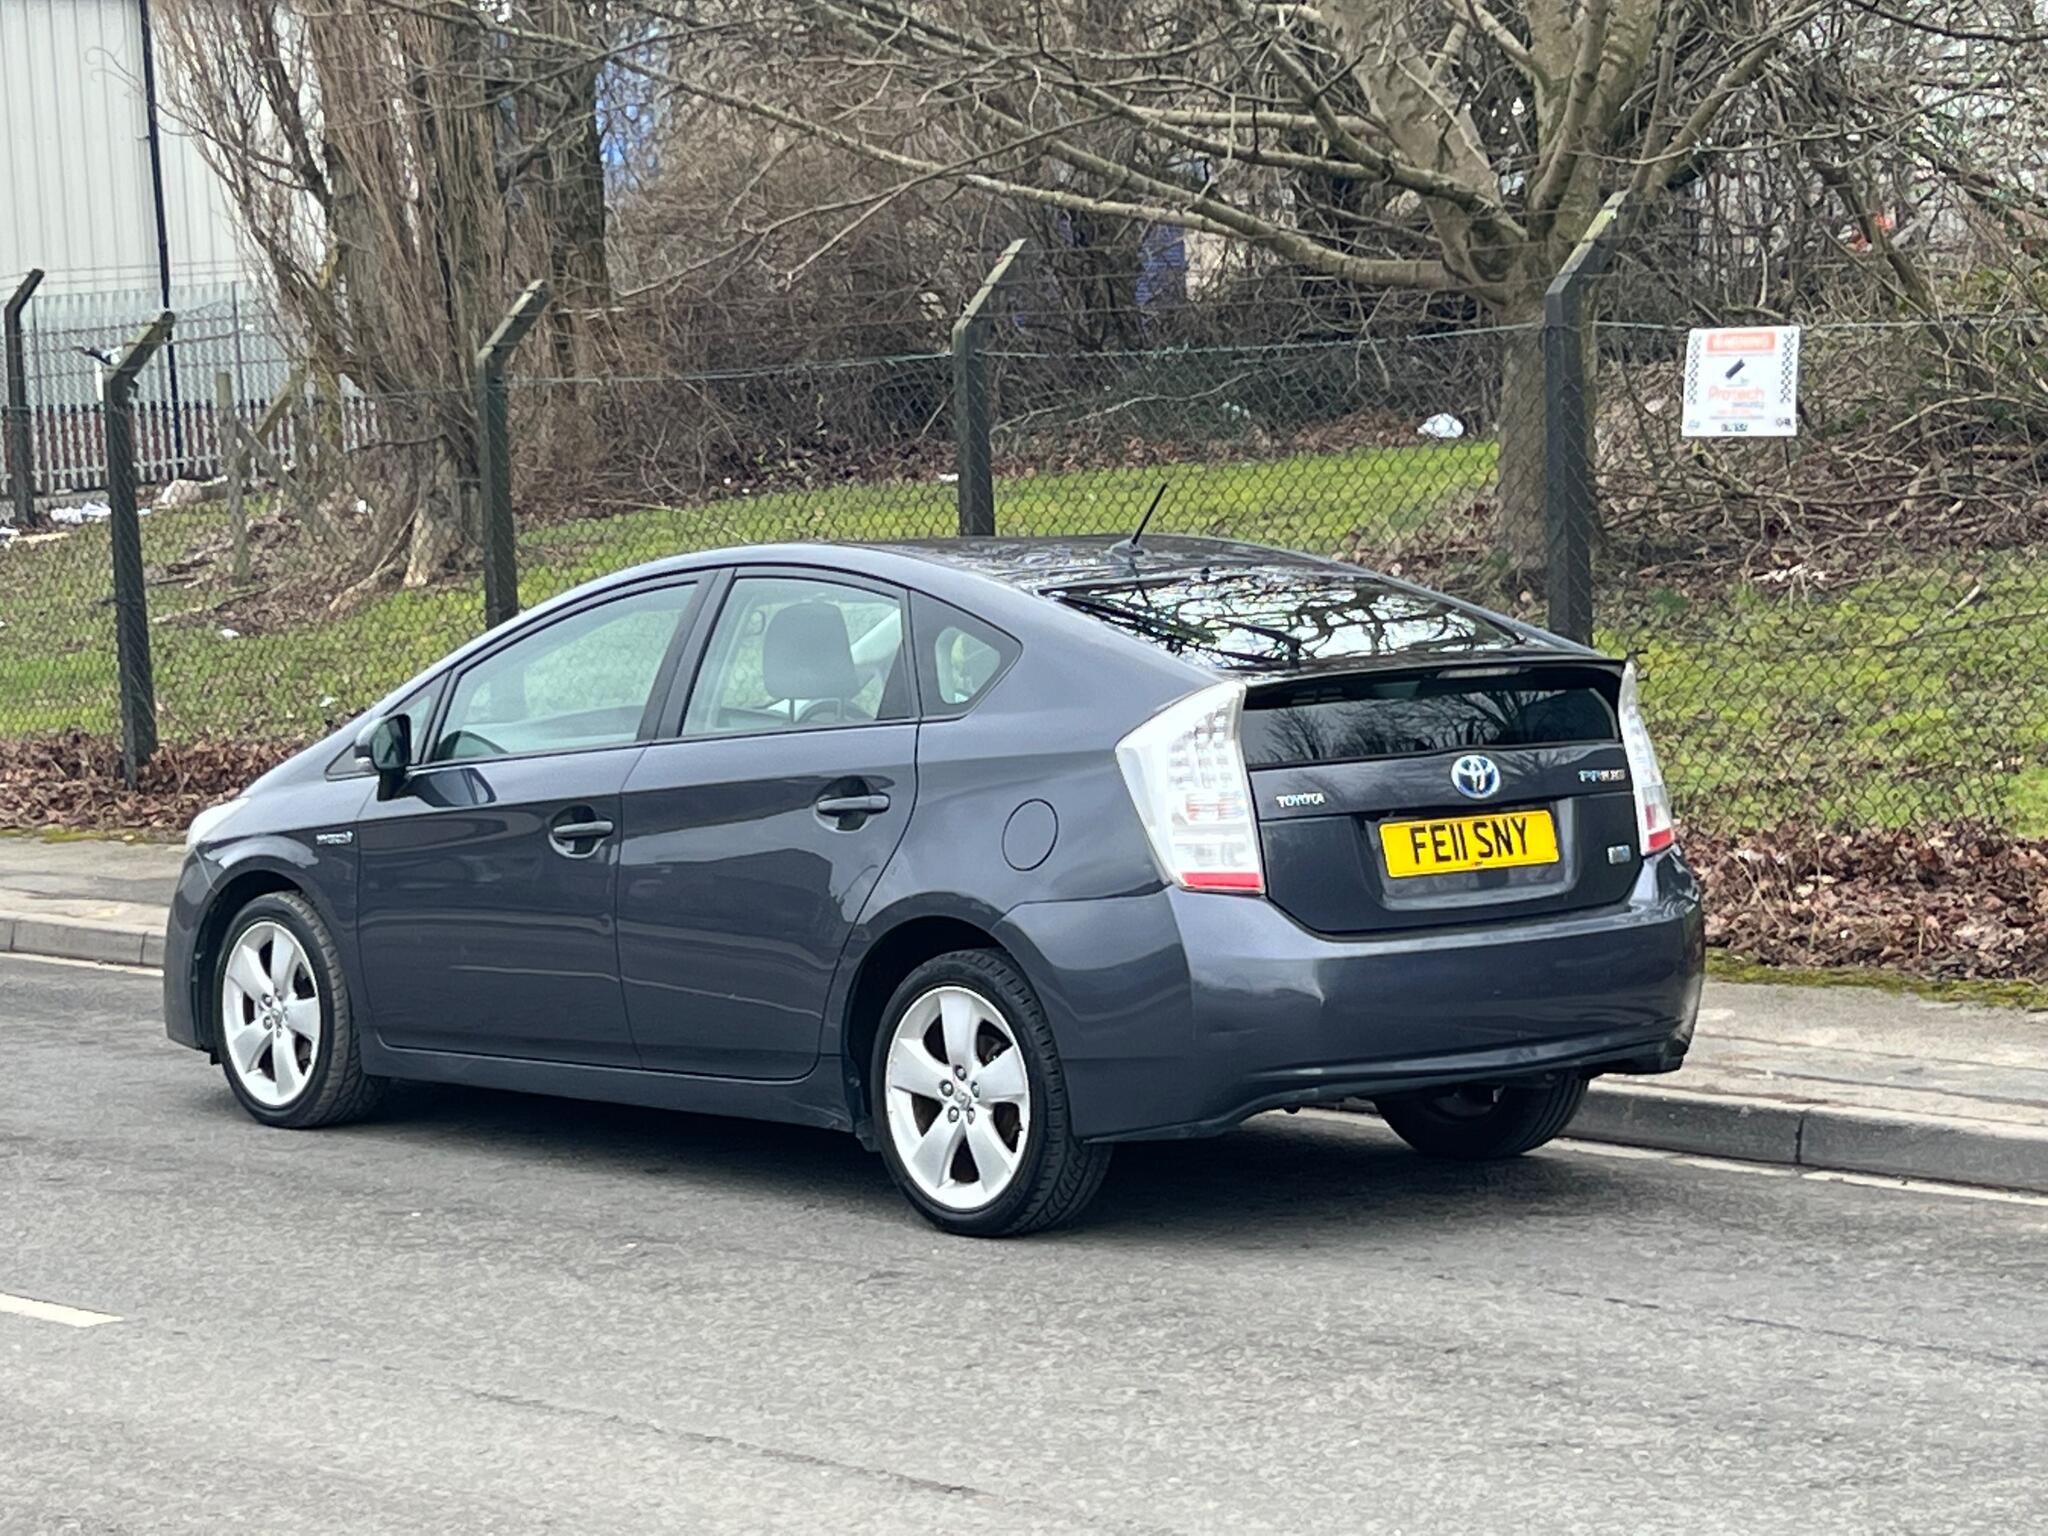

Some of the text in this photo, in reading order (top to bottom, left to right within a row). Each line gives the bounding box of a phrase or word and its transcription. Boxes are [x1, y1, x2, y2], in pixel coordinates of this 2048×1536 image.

[1276, 793, 1325, 807] TOYOTA
[1410, 817, 1527, 864] FE11 SNY
